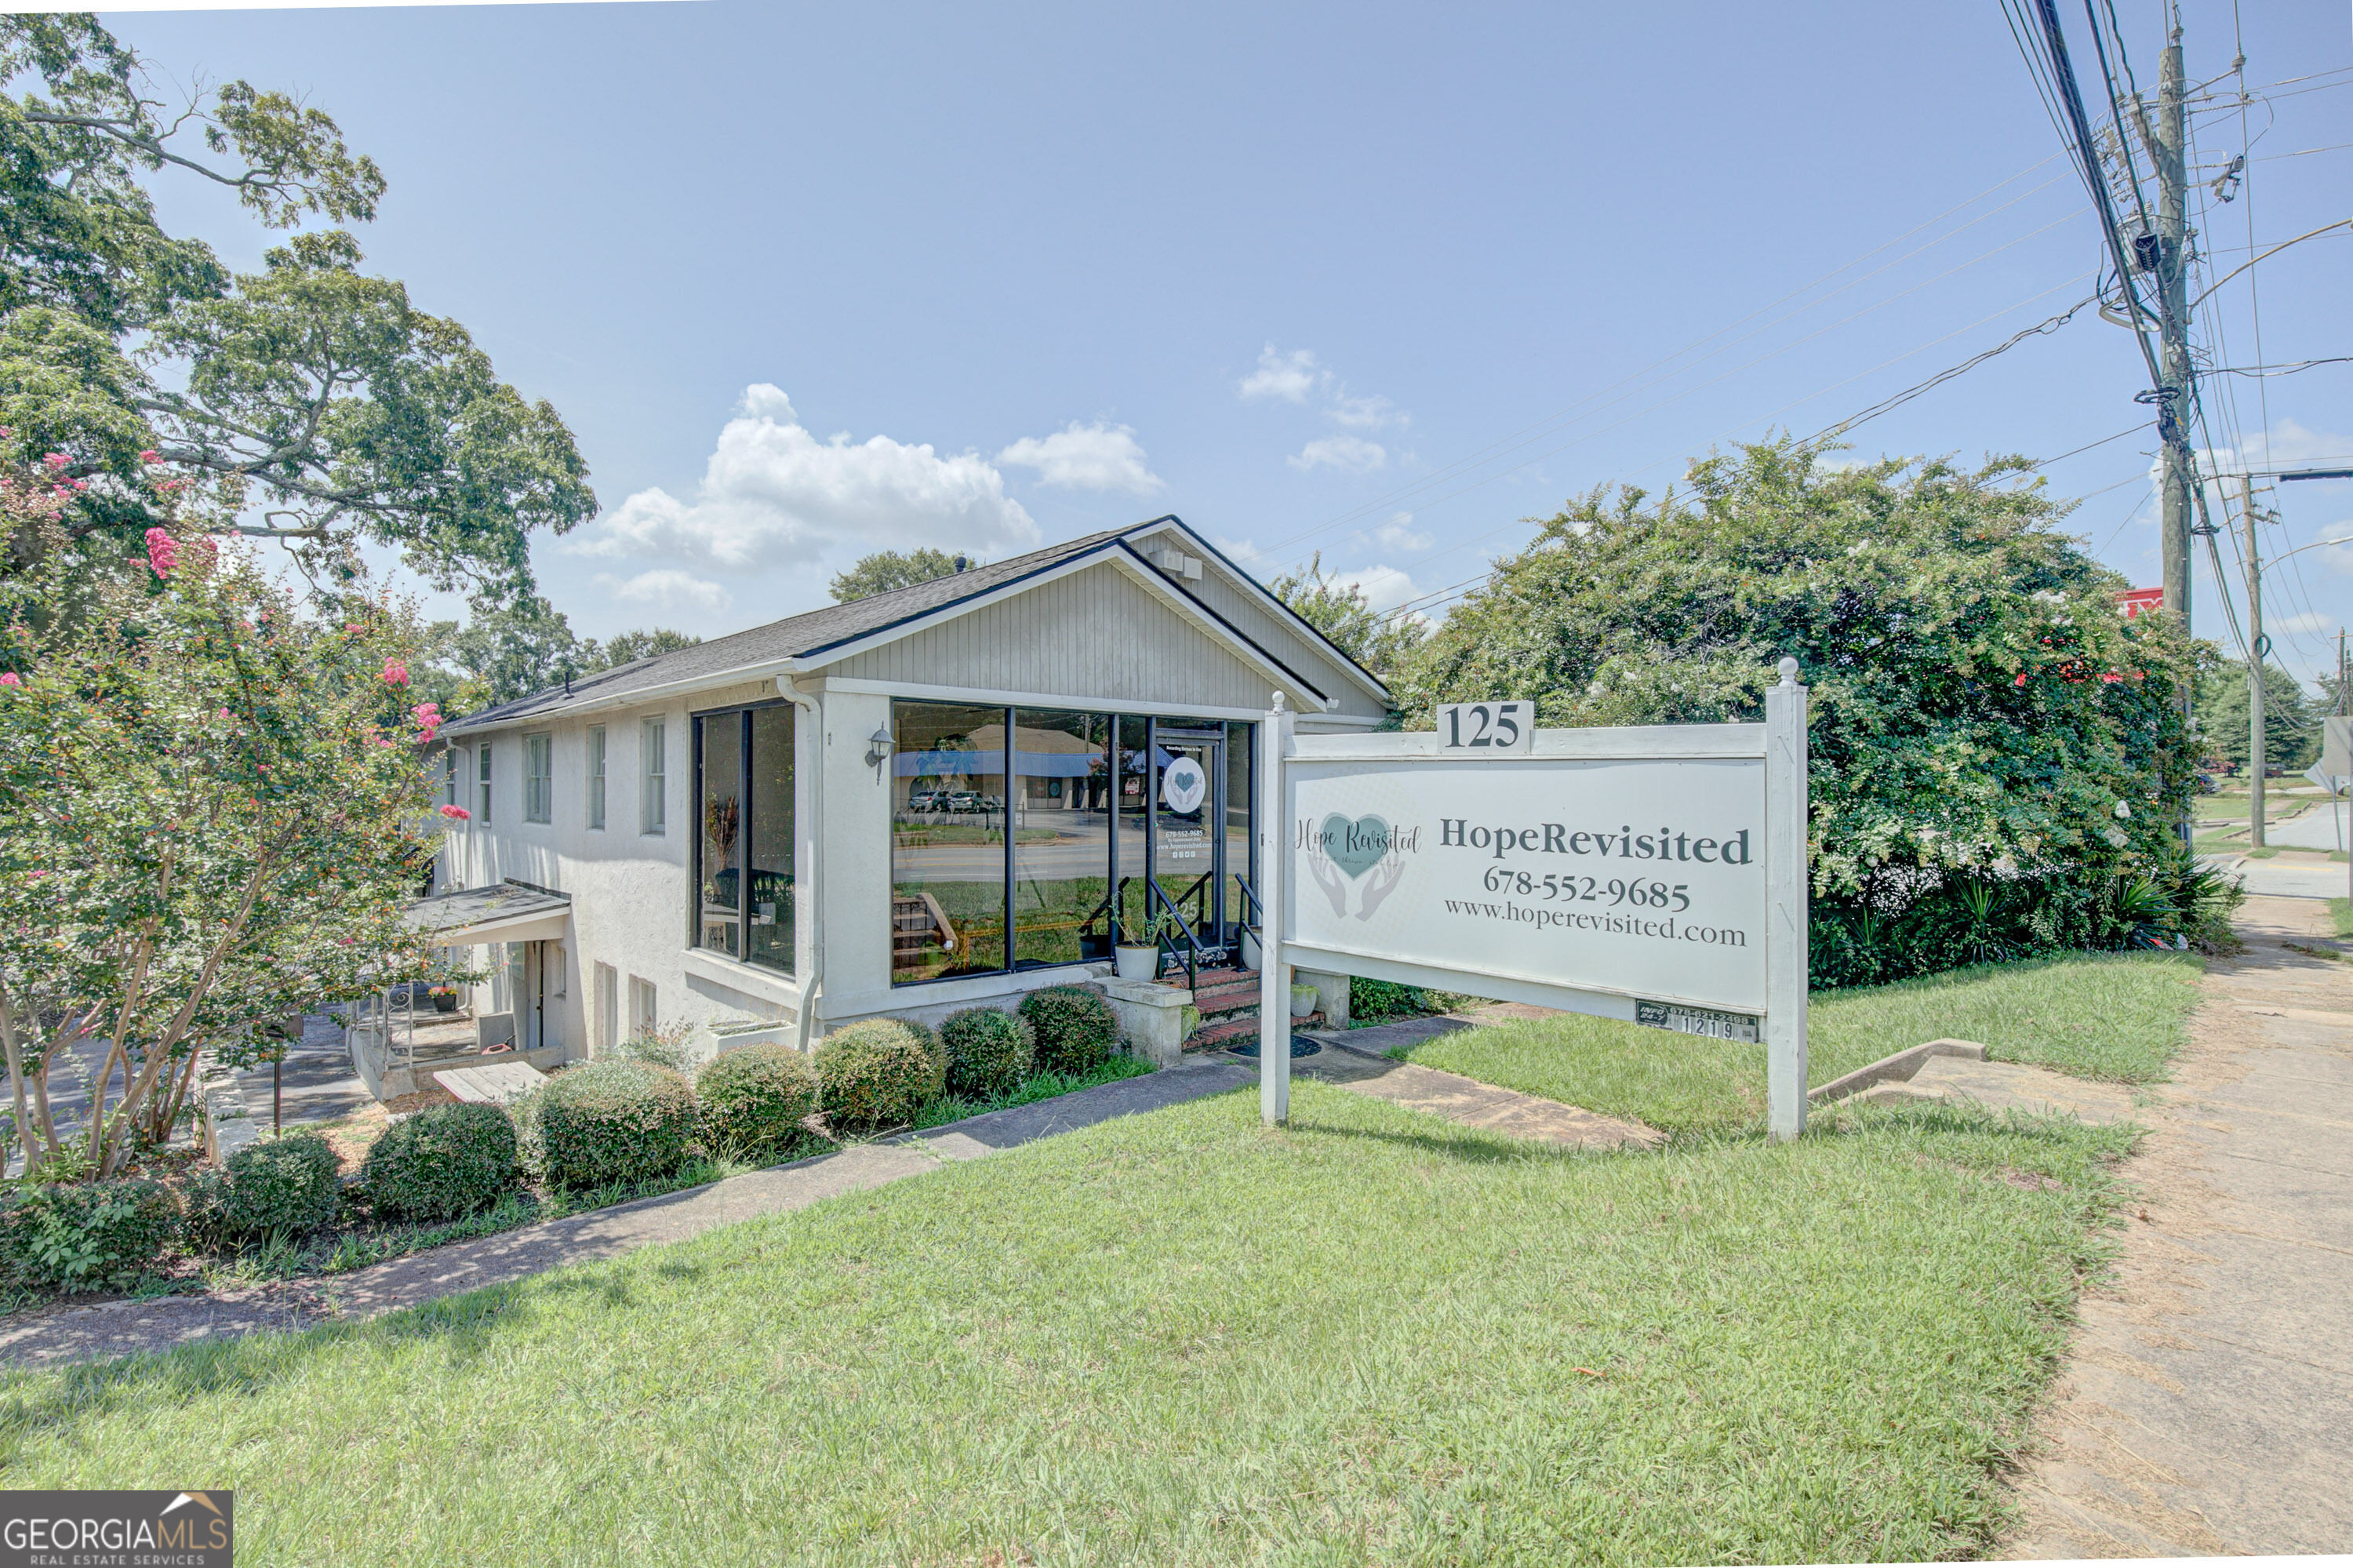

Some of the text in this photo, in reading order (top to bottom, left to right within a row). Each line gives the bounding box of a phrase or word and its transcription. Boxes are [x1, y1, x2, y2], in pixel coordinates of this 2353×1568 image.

[1444, 704, 1518, 748] 125
[1294, 818, 1422, 854] Hope Revisited
[1440, 818, 1753, 865] HopeRevisited
[1484, 866, 1690, 912] 678-552-9685
[1444, 900, 1747, 947] www.hoperevisited.com
[1640, 1006, 1664, 1015] INFO
[1640, 1012, 1666, 1021] 24-7
[1670, 1007, 1749, 1024] 678-621-2498
[1684, 1017, 1733, 1039] 1219
